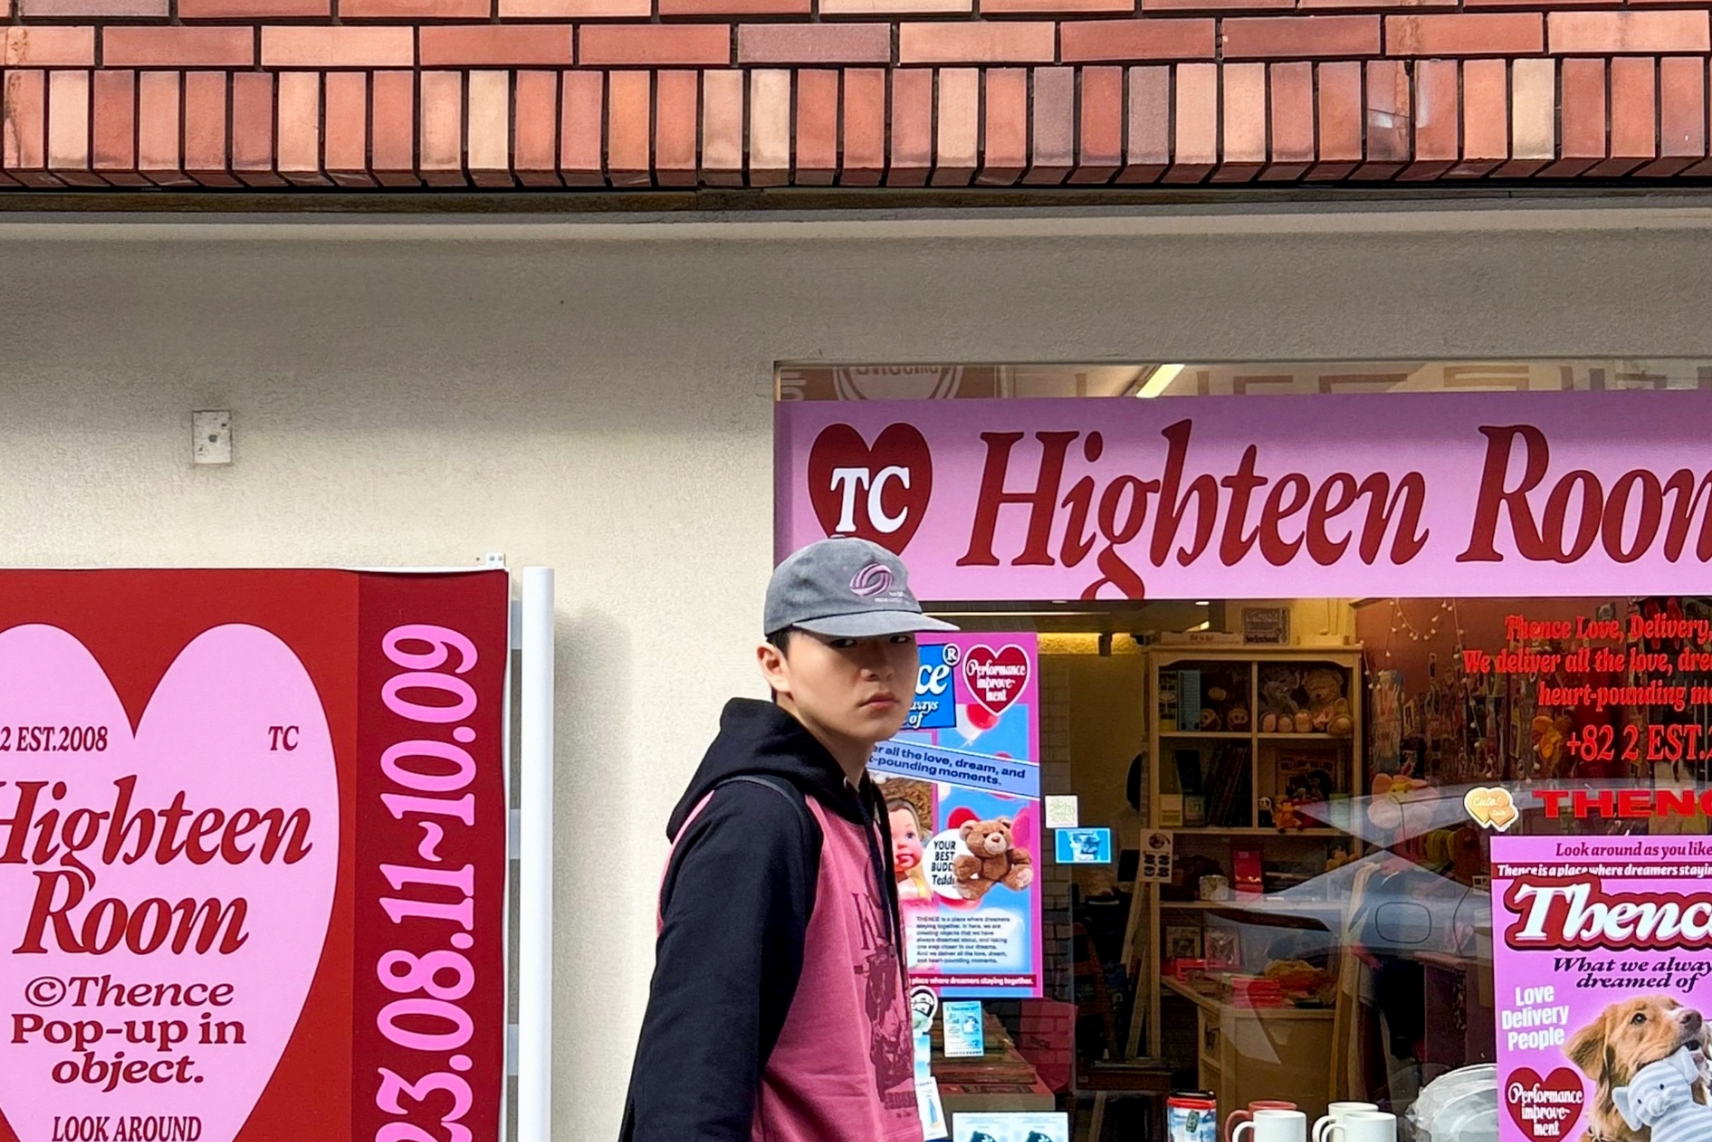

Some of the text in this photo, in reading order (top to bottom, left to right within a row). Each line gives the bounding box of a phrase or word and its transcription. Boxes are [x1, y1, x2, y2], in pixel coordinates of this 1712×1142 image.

[830, 466, 910, 534] TC
[956, 419, 1429, 599] Highteen
[1505, 615, 1570, 640] Thence
[1576, 616, 1624, 643] Love,
[967, 659, 1026, 677] Performance
[1463, 650, 1490, 673] We
[1495, 649, 1560, 672] deliver
[1565, 648, 1590, 671] all
[1595, 648, 1624, 671] the
[1630, 647, 1673, 676] love,
[1539, 680, 1685, 711] heart-pounding
[16, 726, 108, 751] EST.2008
[269, 726, 300, 751] TC
[1566, 724, 1615, 761] +82
[1621, 724, 1639, 761] 2
[885, 745, 900, 757] all
[901, 748, 922, 761] the
[923, 751, 953, 768] love,
[955, 758, 999, 776] dream,
[1001, 766, 1026, 779] and
[938, 768, 1002, 786] moments.
[0, 775, 313, 891] Highteen
[933, 840, 956, 850] YOUR
[935, 851, 955, 861] BEST
[1556, 842, 1590, 857] Look
[1591, 842, 1642, 857] around
[1644, 845, 1659, 857] as
[1661, 845, 1686, 860] you
[1497, 864, 1538, 876] Thence
[1538, 865, 1548, 875] is
[1549, 866, 1557, 875] a
[1589, 863, 1623, 876] where
[1624, 863, 1678, 876] dreamers
[12, 870, 249, 955] Room
[1554, 957, 1616, 972] What
[1621, 960, 1649, 972] we
[1576, 972, 1700, 993] dreamed of
[1515, 985, 1555, 1007] Love
[1501, 1005, 1569, 1030] Delivery
[10, 1012, 247, 1052] Pop-up in
[1508, 1027, 1565, 1051] People
[51, 1051, 204, 1093] object.
[1508, 1082, 1584, 1104] Performance
[1521, 1104, 1571, 1122] improve-
[52, 1116, 202, 1142] LOOK AROUND
[1533, 1119, 1561, 1136] ment
